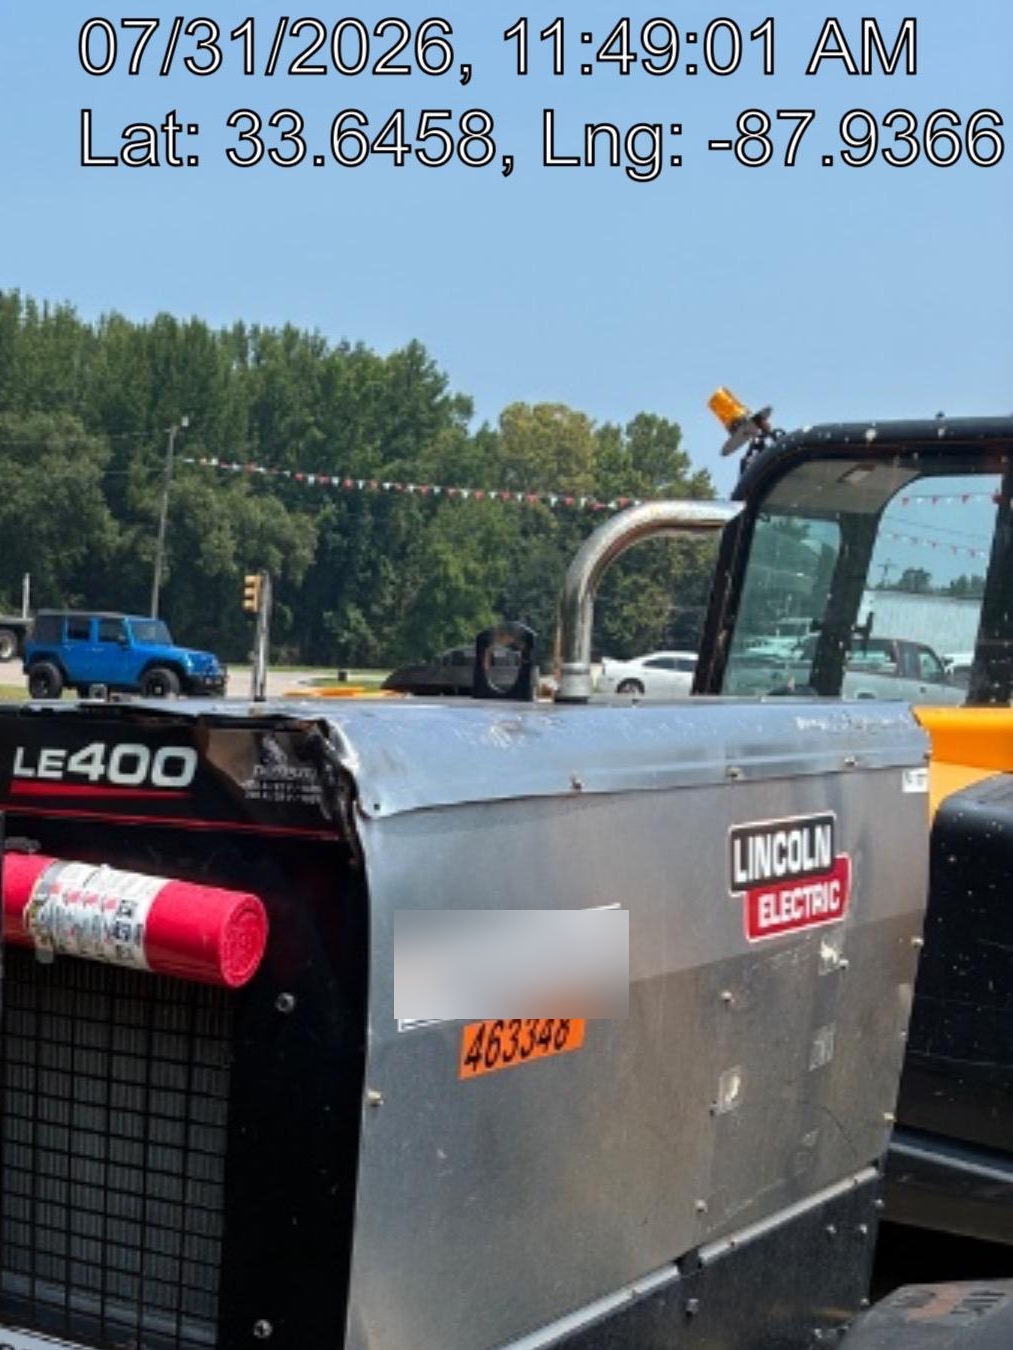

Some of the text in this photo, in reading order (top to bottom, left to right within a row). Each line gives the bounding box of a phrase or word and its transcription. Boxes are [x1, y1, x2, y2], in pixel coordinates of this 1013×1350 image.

[12, 743, 198, 787] LE400
[733, 823, 832, 883] LINCOLN
[757, 879, 841, 928] ELECTRIC
[463, 1018, 571, 1071] 463348
